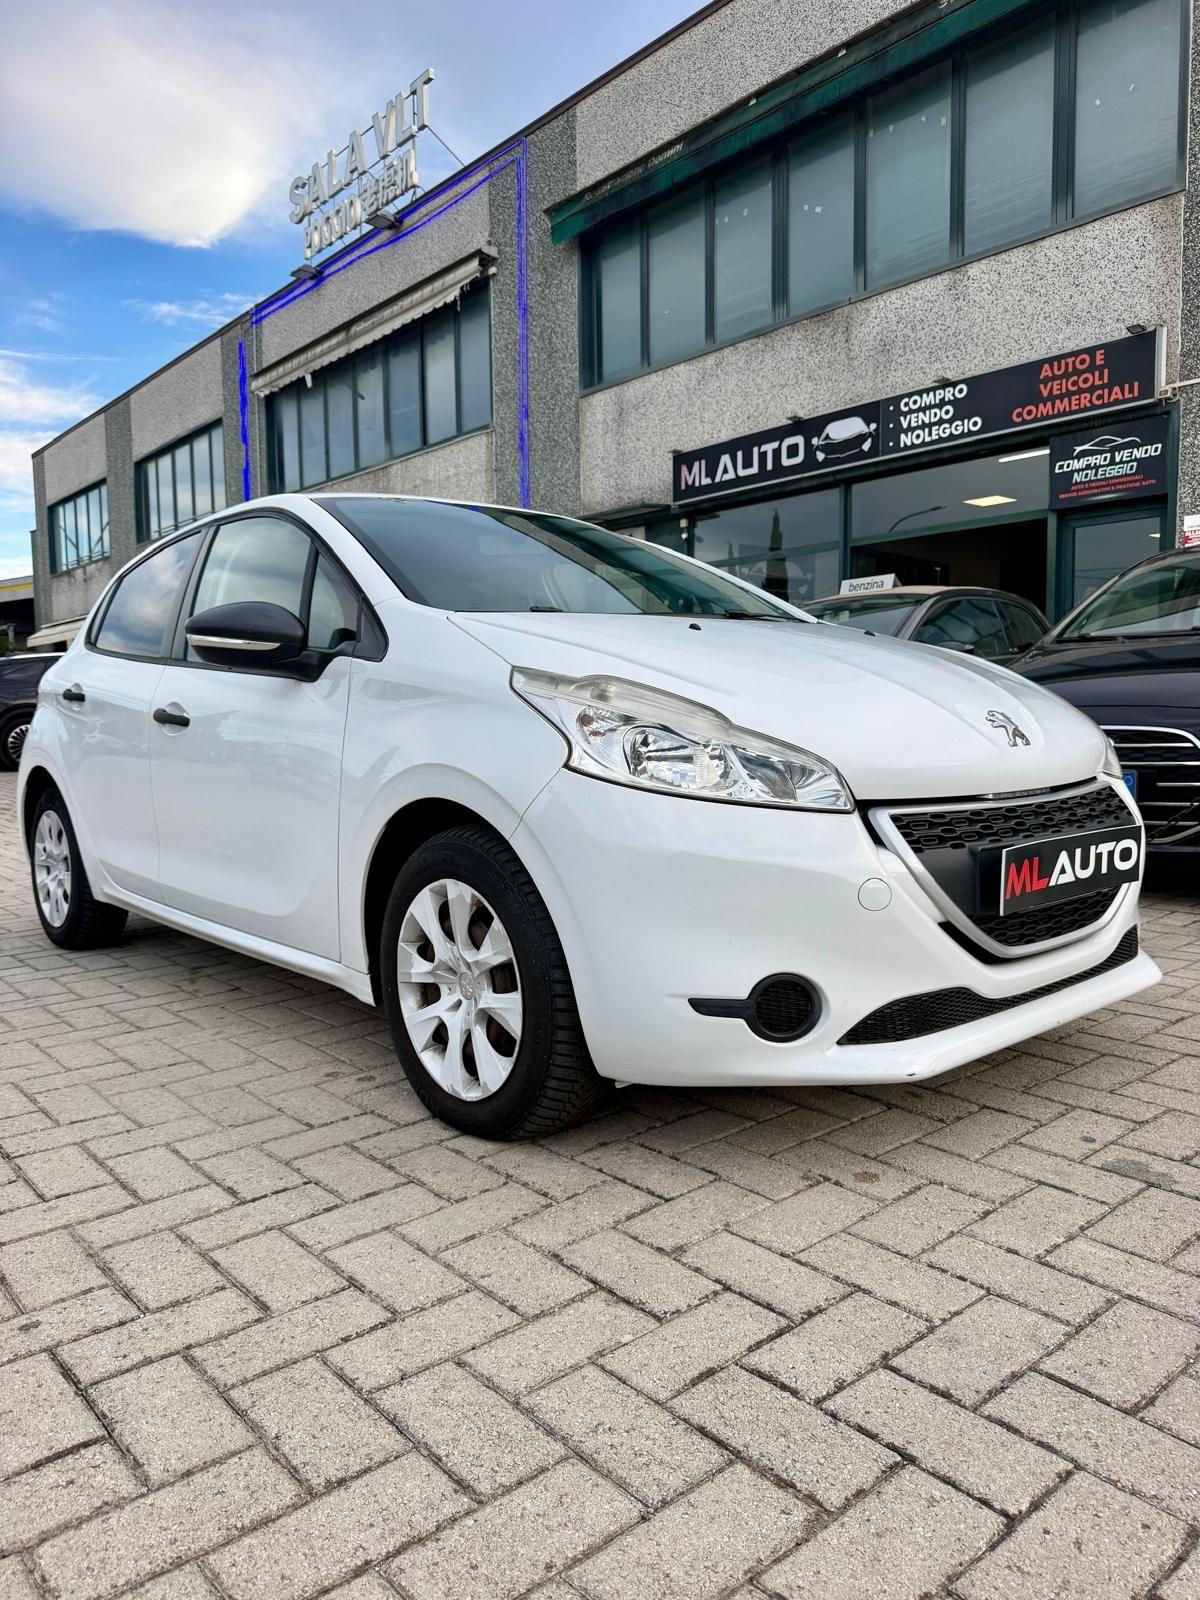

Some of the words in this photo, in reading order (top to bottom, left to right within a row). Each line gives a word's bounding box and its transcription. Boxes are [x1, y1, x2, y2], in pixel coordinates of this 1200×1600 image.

[289, 130, 369, 224] SALA
[371, 67, 435, 160] VLT
[1039, 353, 1090, 379] AUTO
[1095, 350, 1105, 366] E
[899, 383, 968, 413] COMPRO
[1039, 369, 1108, 398] VEICOLI
[1011, 381, 1140, 424] COMMERCIALI
[899, 405, 954, 431] VENDO
[899, 416, 983, 449] NOLEGGIO
[1054, 453, 1111, 474] COMPRO
[1114, 443, 1162, 463] VENDO
[1072, 462, 1138, 484] NOLEGGIO
[848, 579, 885, 592] benzina
